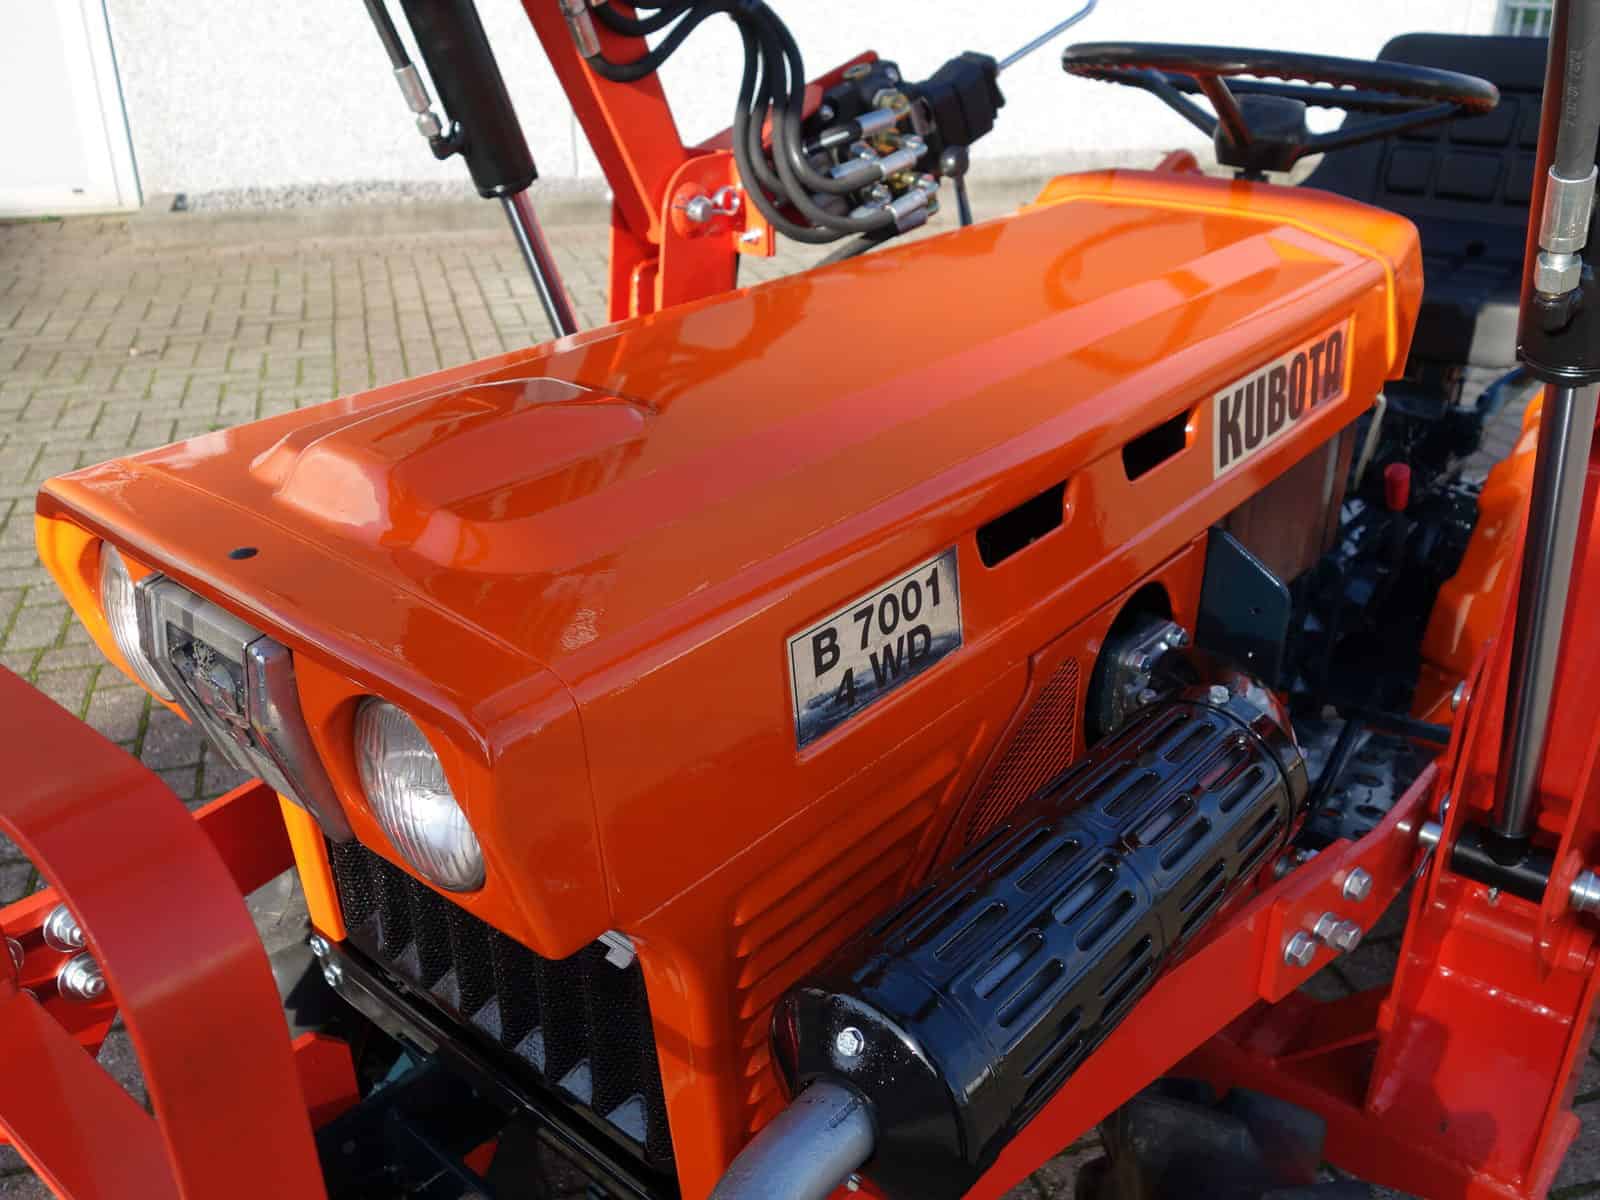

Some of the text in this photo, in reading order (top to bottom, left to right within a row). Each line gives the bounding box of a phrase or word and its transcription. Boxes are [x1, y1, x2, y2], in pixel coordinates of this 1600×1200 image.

[1219, 330, 1343, 470] KUBOTA
[812, 567, 941, 678] B 7001
[834, 624, 932, 706] 4 WD
